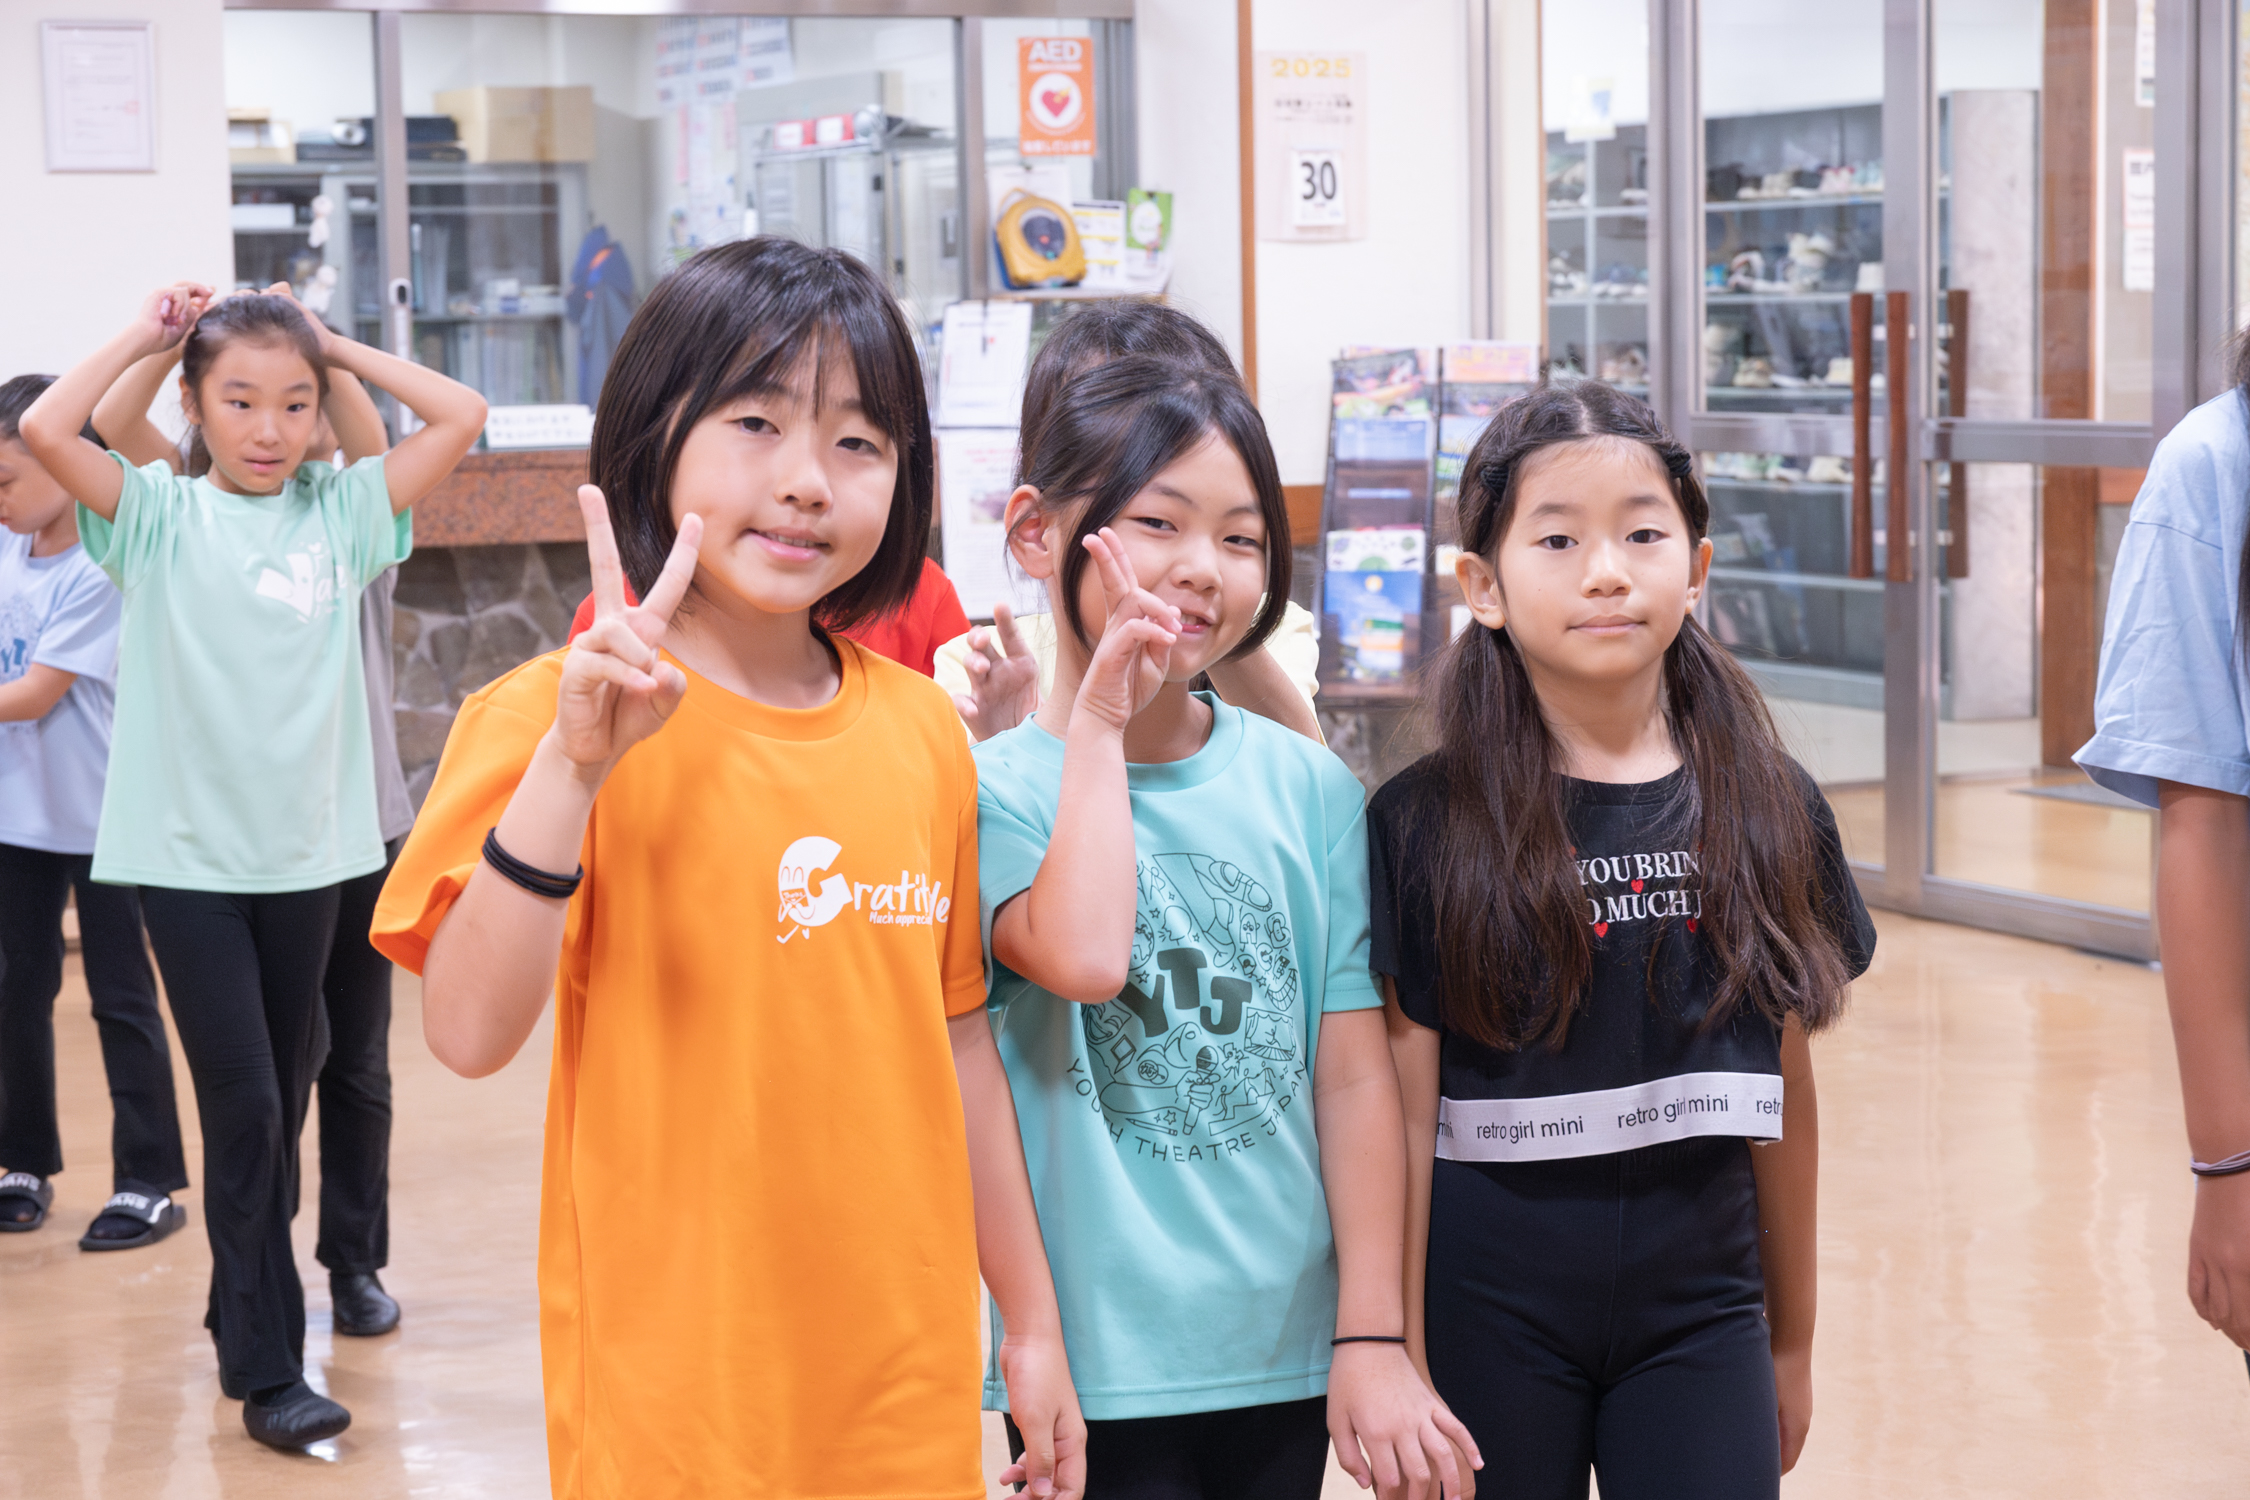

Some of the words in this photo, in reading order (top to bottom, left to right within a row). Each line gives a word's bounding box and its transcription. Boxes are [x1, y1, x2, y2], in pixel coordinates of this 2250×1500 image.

[1028, 40, 1083, 62] AED
[1271, 58, 1352, 78] 2025
[1301, 160, 1337, 200] 30
[1577, 854, 1631, 886] YOU
[869, 911, 894, 924] Much
[1604, 889, 1691, 923] MUCH
[1116, 947, 1253, 1038] YTJ
[1134, 1131, 1256, 1162] THEATRE
[1260, 1060, 1306, 1136] JAPAN
[1476, 1122, 1507, 1139] retro
[1509, 1120, 1535, 1144] girl
[1540, 1115, 1584, 1138] mini
[1617, 1106, 1659, 1129] retro
[1664, 1096, 1686, 1123] girl
[1688, 1094, 1729, 1114] mini
